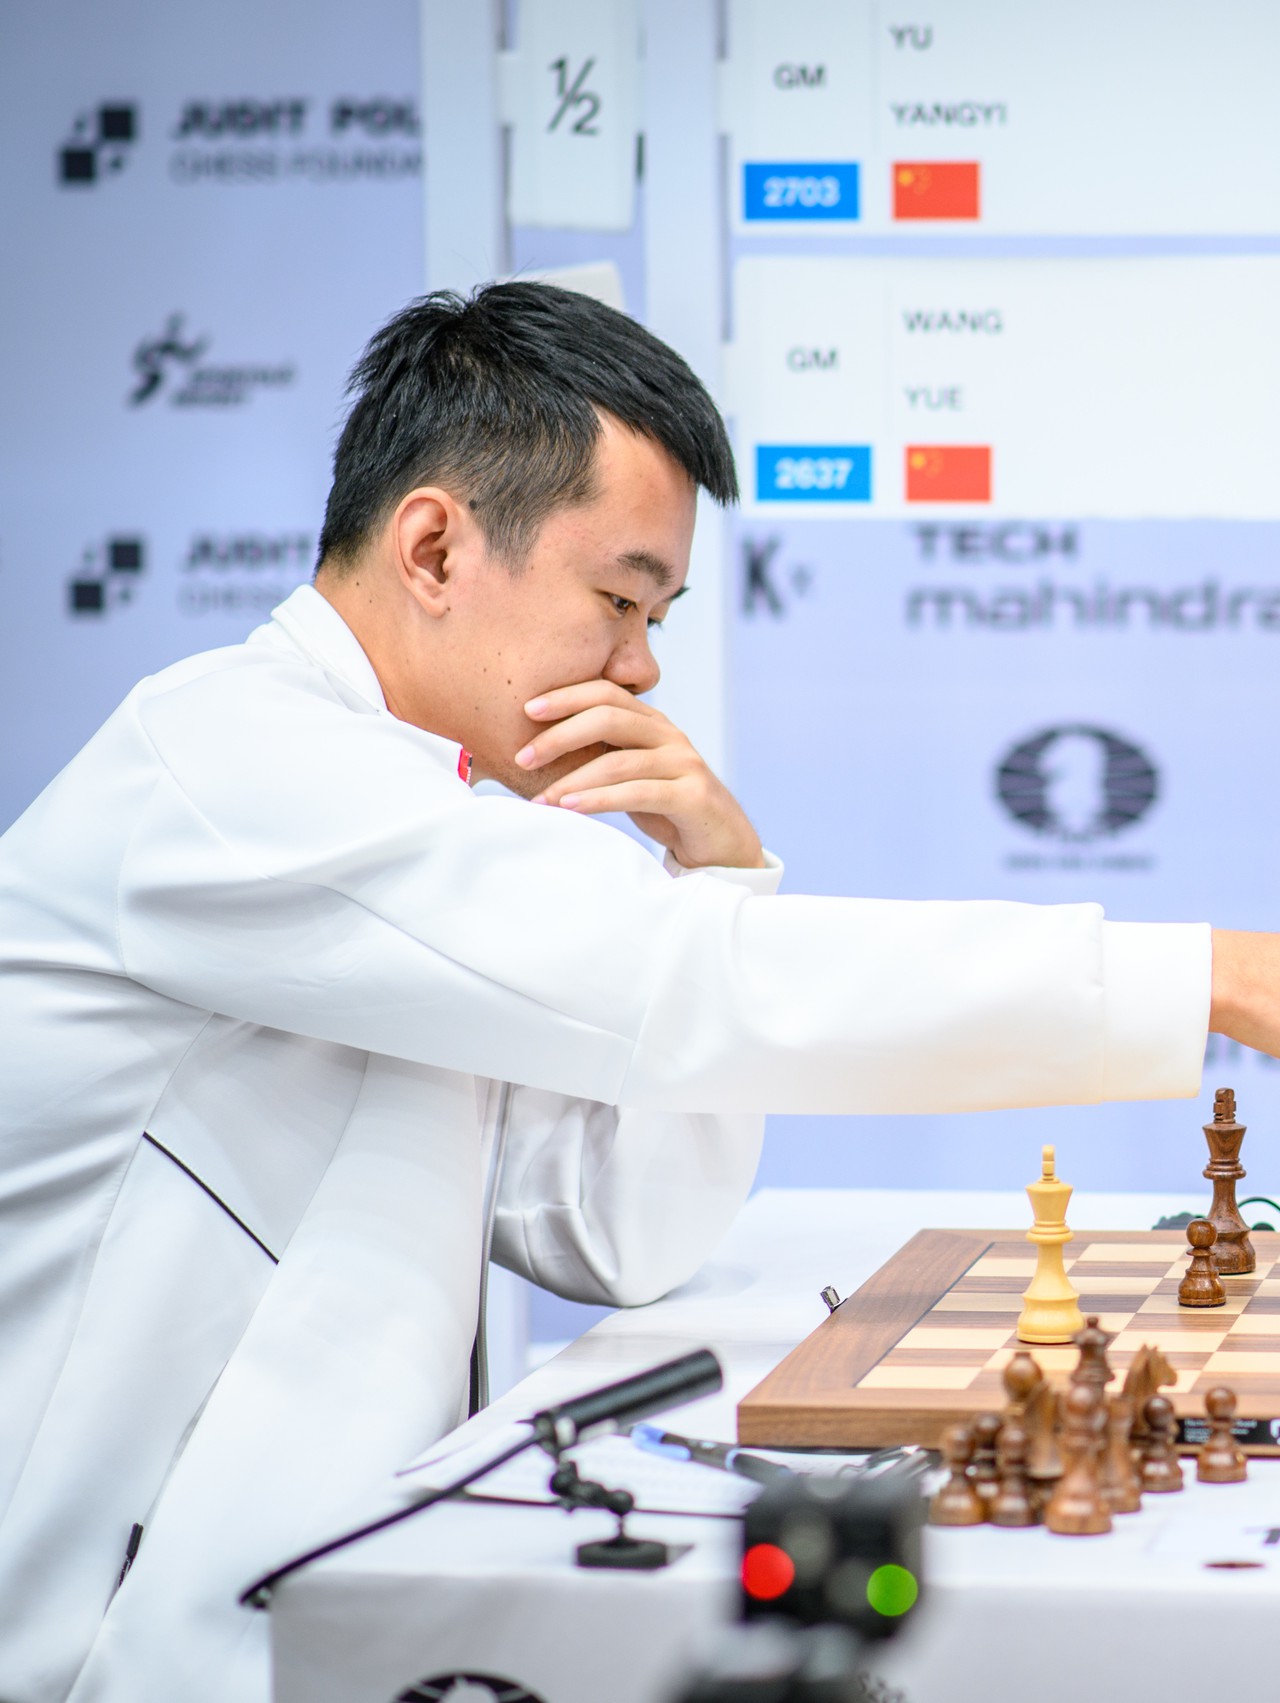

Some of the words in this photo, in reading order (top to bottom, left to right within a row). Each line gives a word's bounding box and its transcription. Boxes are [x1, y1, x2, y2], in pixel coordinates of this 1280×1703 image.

[889, 25, 933, 50] YU
[774, 63, 828, 90] GM
[891, 101, 1008, 127] YANGYI
[763, 176, 841, 208] 2703
[904, 309, 1004, 335] WANG
[787, 346, 839, 372] GM
[905, 385, 964, 412] YUE
[774, 458, 853, 490] 2637
[913, 524, 1078, 562] TECH
